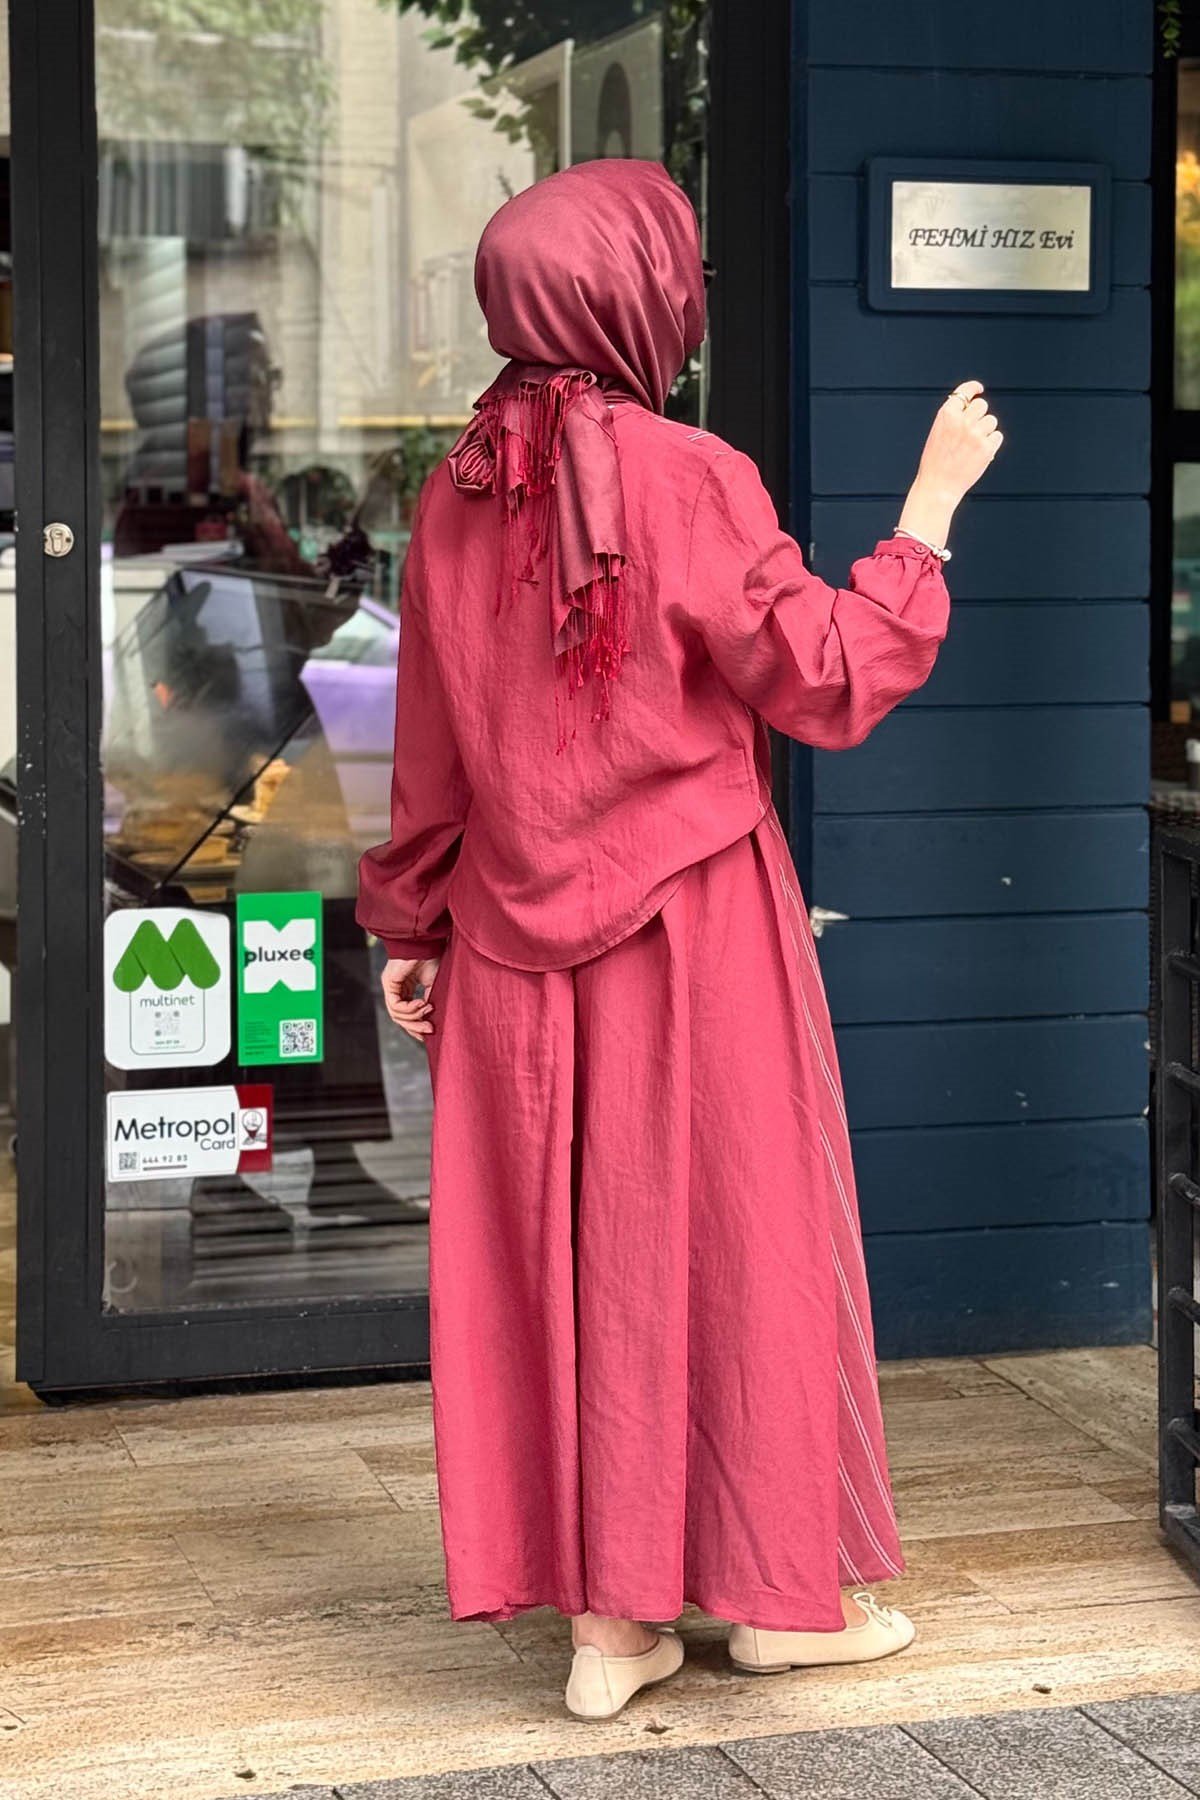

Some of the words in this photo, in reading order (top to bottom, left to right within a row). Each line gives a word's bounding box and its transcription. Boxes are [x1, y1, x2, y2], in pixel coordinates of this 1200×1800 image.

[908, 225, 988, 248] FEHMİ
[990, 228, 1036, 249] HIZ
[1039, 230, 1075, 250] Evi
[243, 946, 316, 966] pluxee
[139, 994, 196, 1008] multinet
[114, 1112, 236, 1142] Metropol
[200, 1137, 236, 1151] Card
